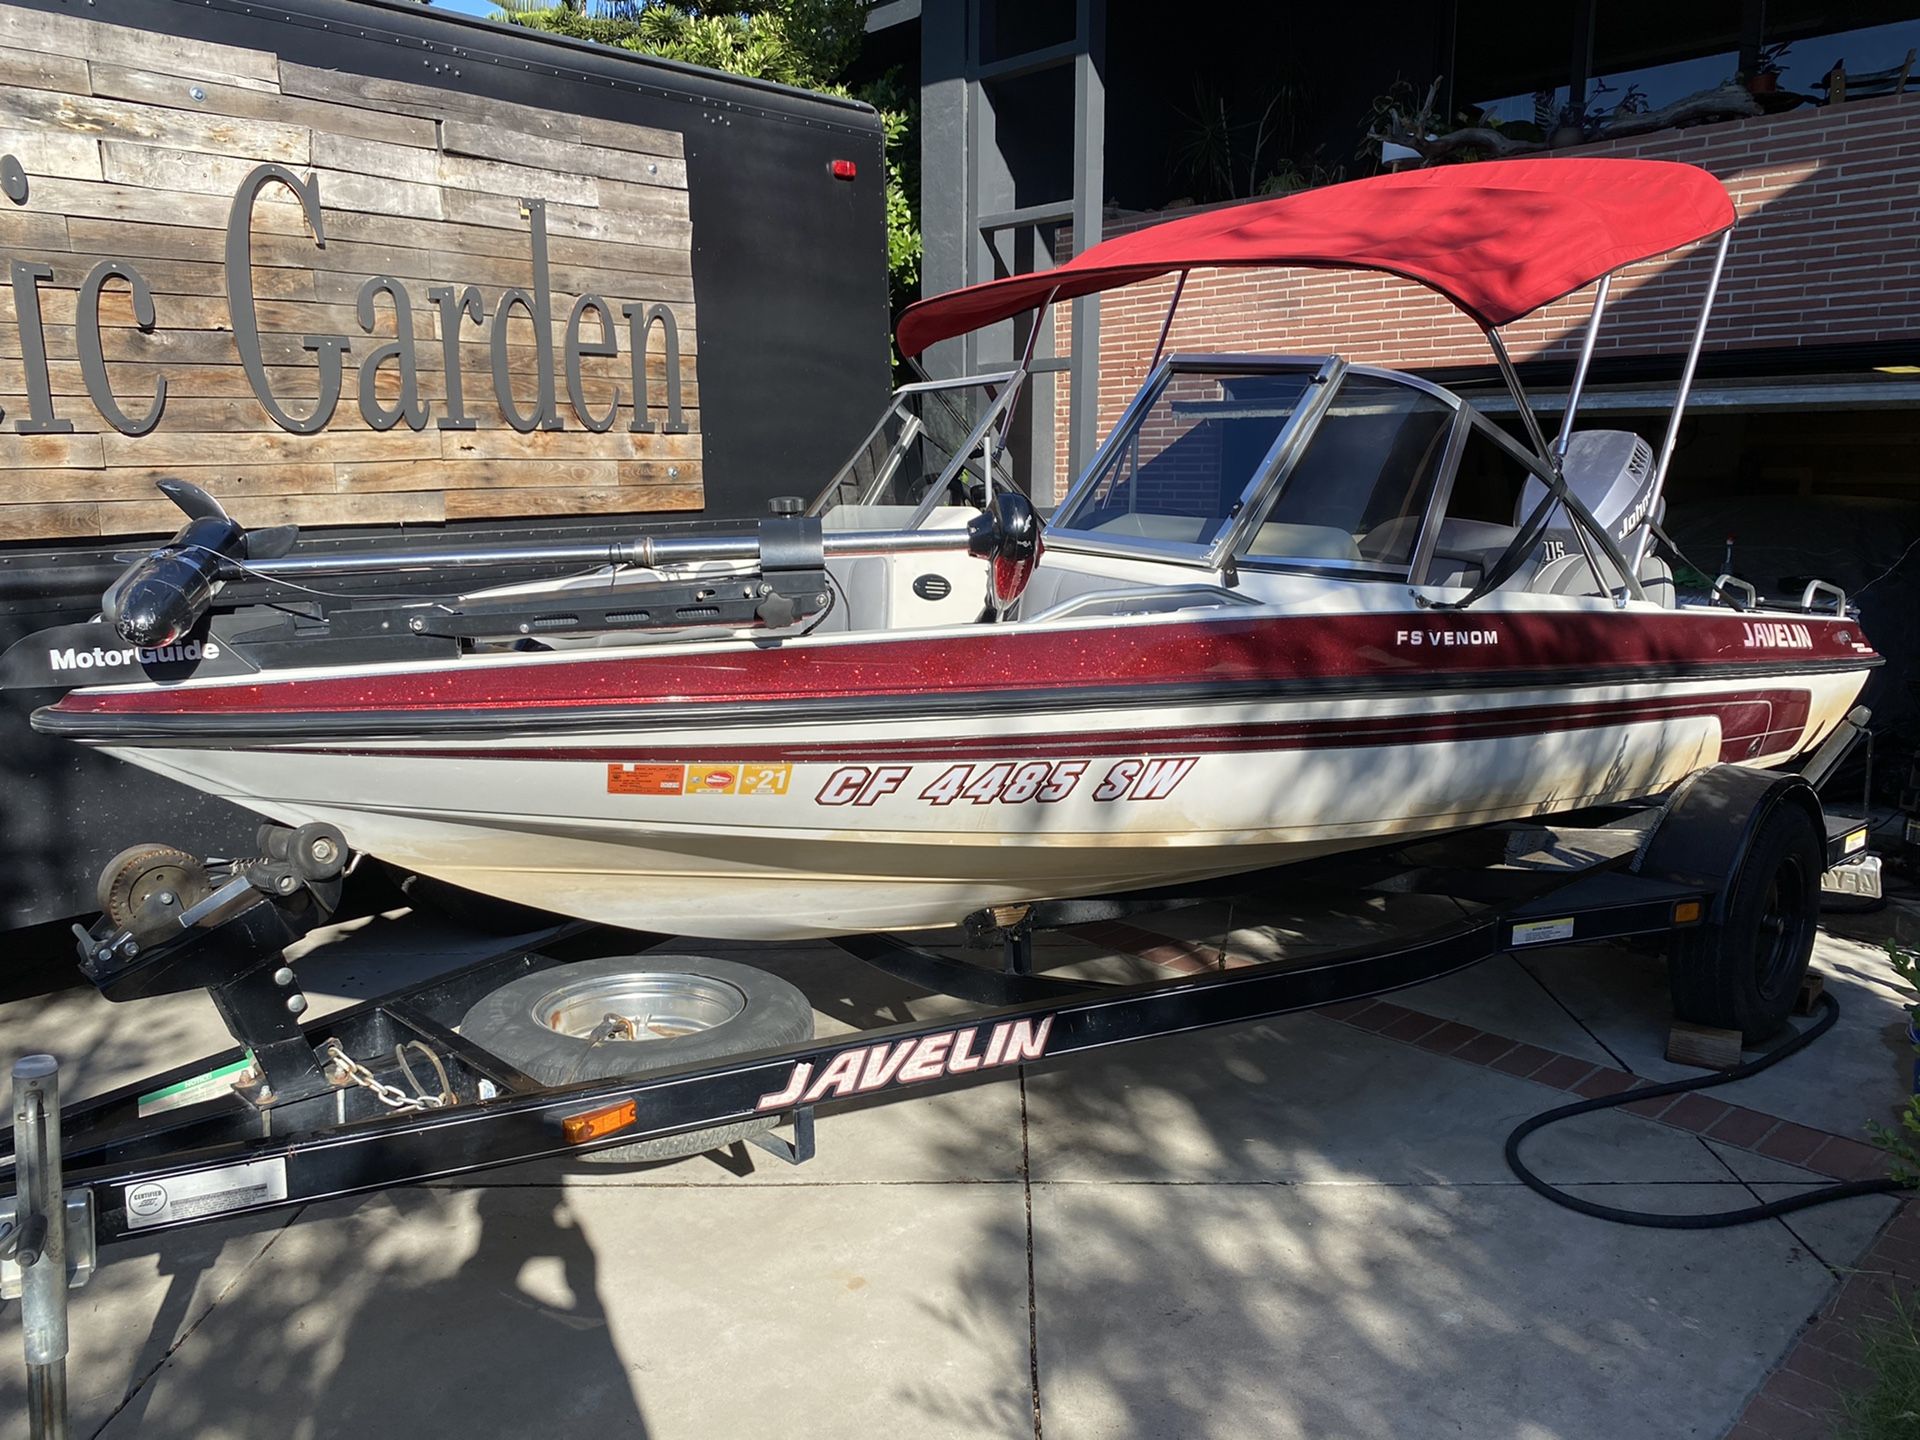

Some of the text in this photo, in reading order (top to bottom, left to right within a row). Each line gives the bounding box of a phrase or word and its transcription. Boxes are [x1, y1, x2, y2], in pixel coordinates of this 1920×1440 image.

[0, 155, 688, 436] ic Garden
[1618, 470, 1657, 540] John
[1543, 541, 1565, 560] 115
[1397, 630, 1498, 646] FS VENOM
[1743, 622, 1813, 649] JAVELIN
[50, 640, 219, 671] MotorGuide
[757, 769, 787, 789] 21
[814, 757, 1200, 806] CF 4485 SW
[756, 1014, 1055, 1111] JAVELIN
